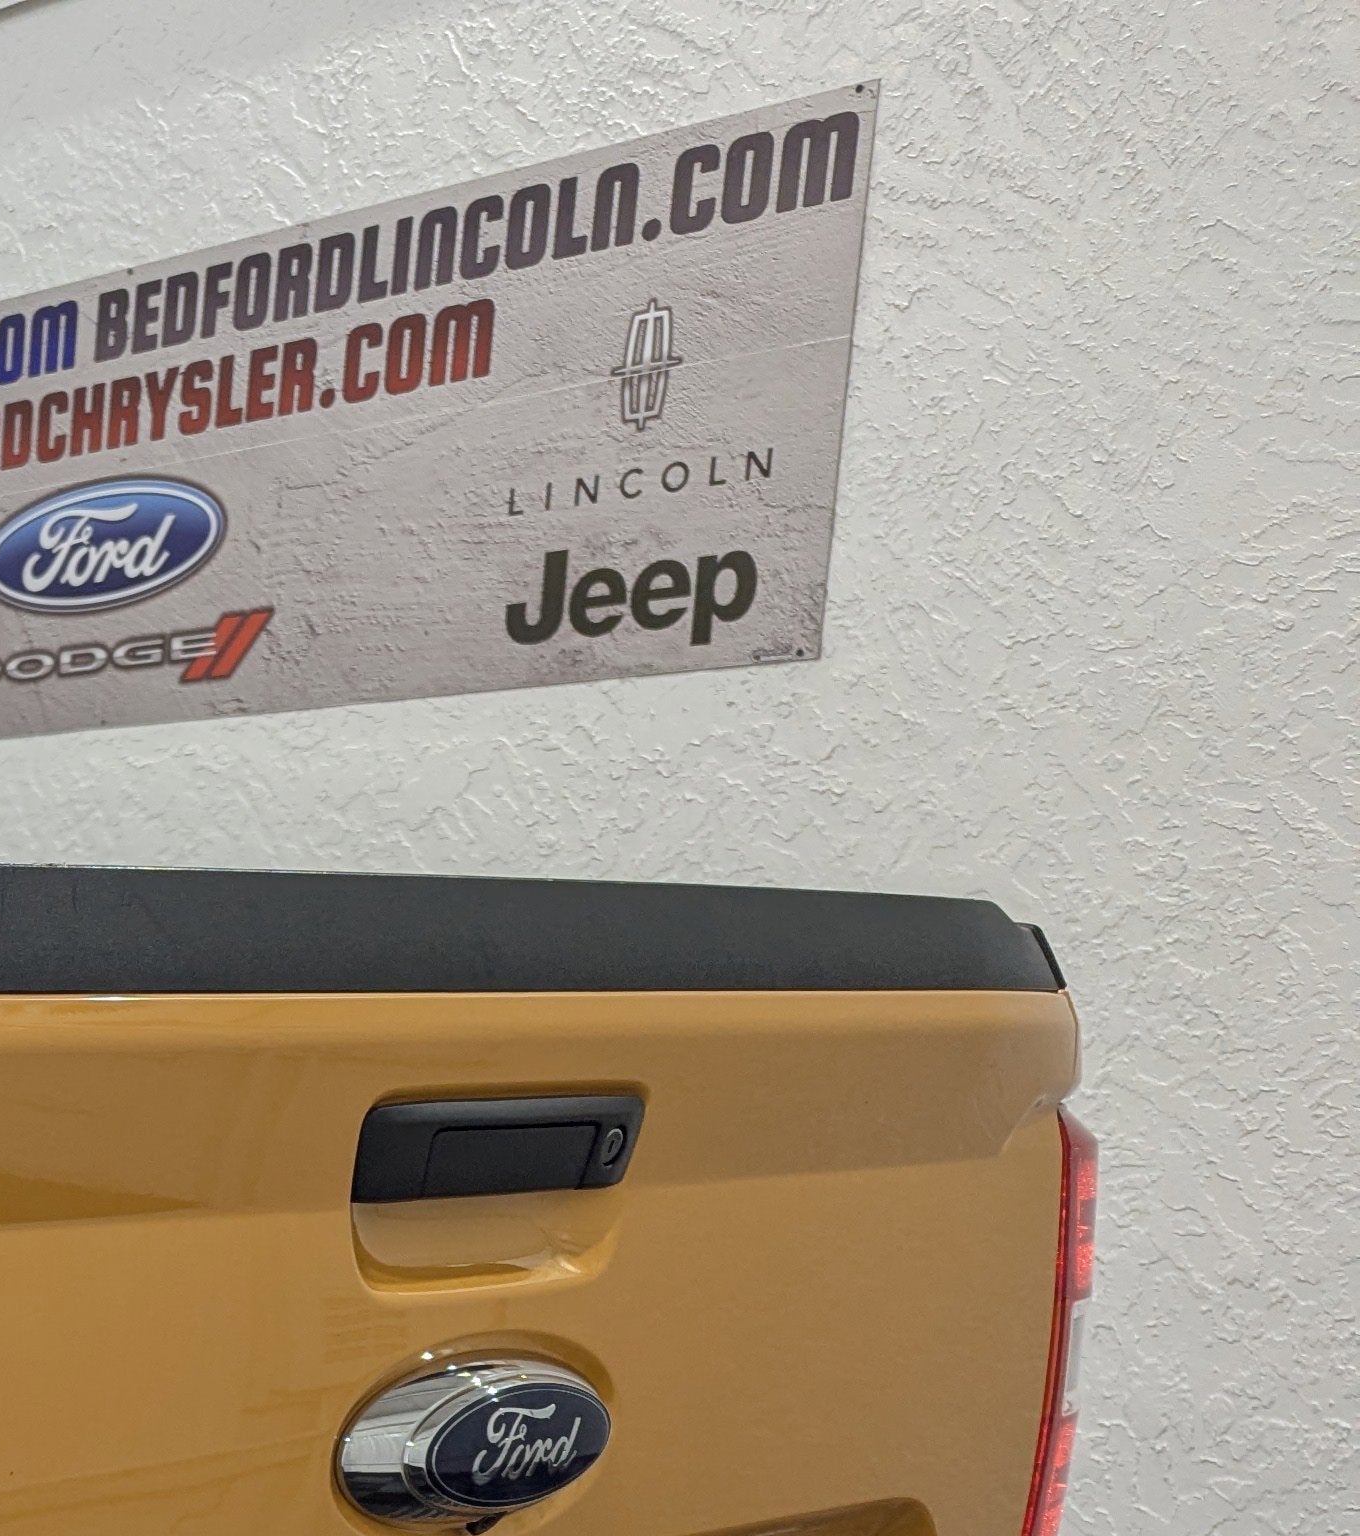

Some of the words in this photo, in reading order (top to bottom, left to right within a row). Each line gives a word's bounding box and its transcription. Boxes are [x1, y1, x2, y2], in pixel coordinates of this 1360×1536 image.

[94, 111, 860, 363] BEDFORDLINCOLN.COM
[505, 447, 774, 516] LINCOLN
[22, 502, 176, 592] Ford
[505, 549, 758, 646] Jeep
[473, 1403, 581, 1478] Ford
